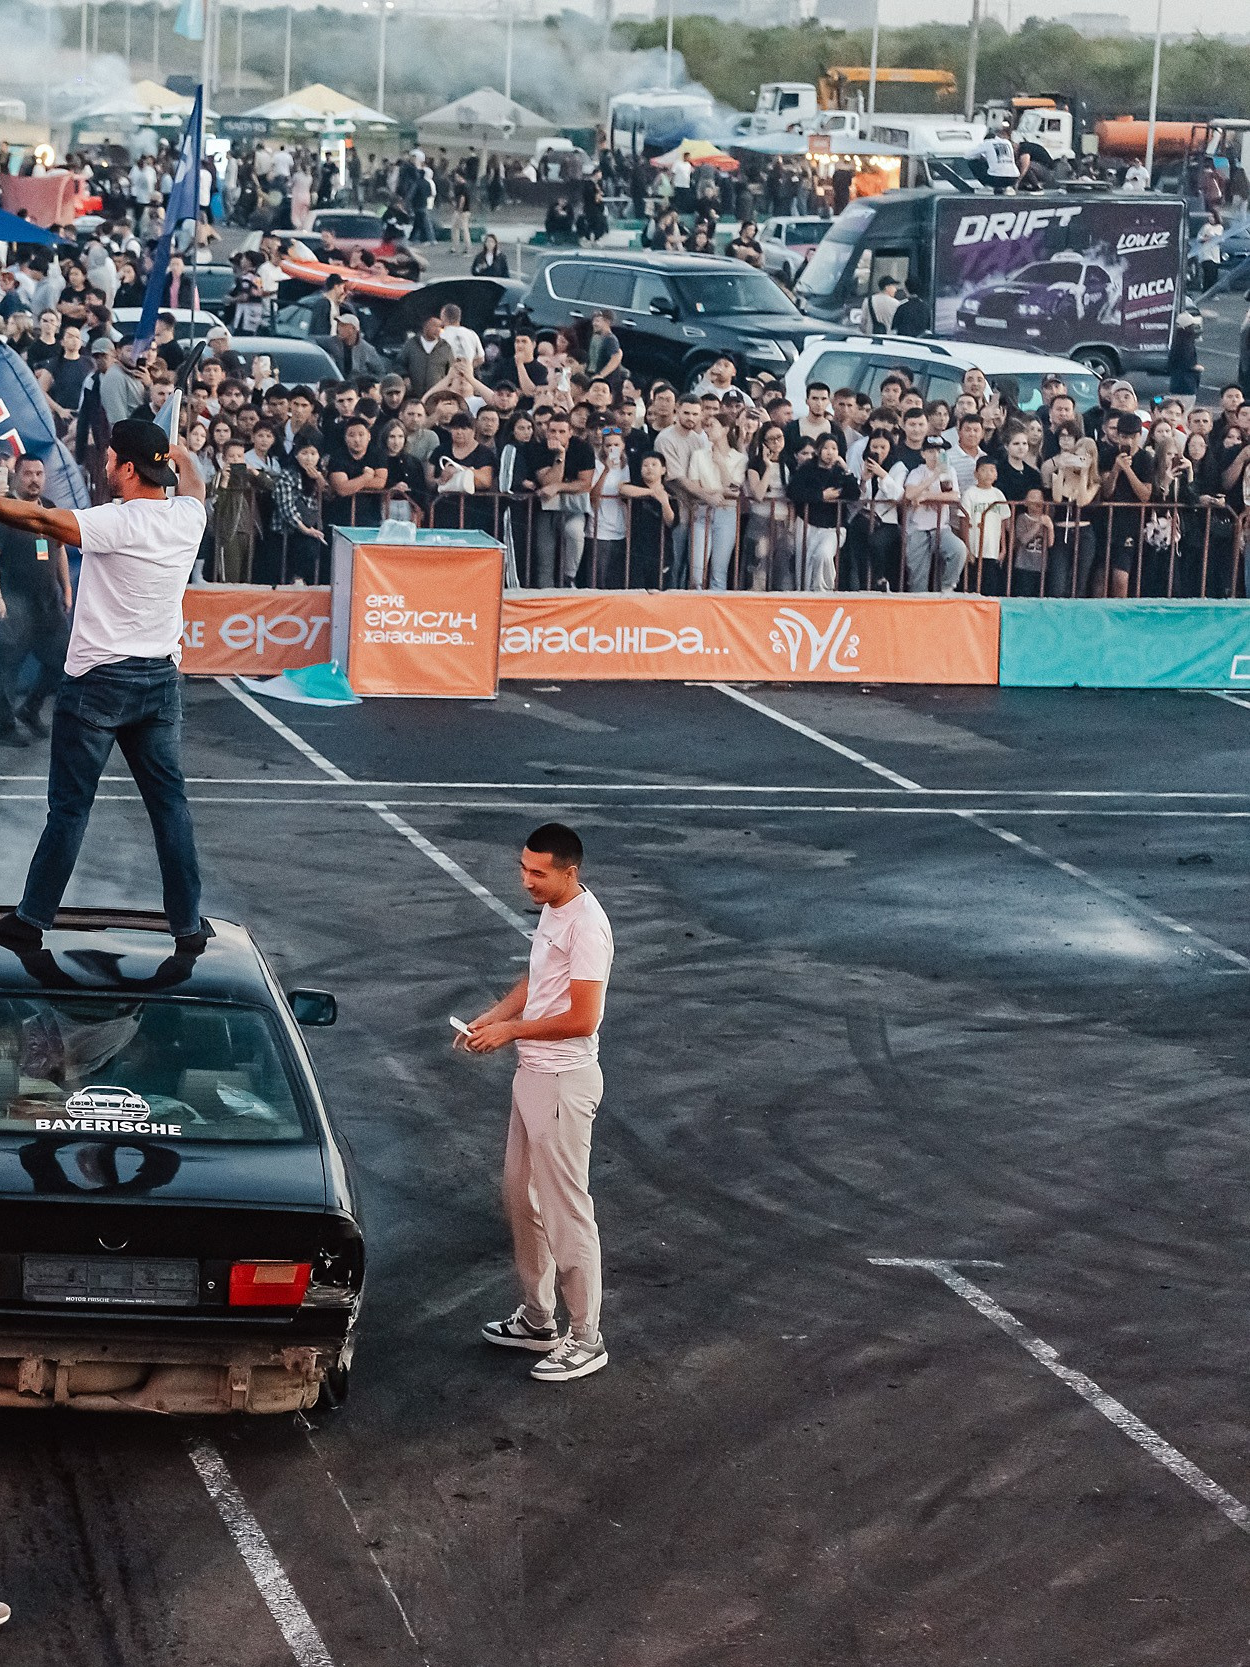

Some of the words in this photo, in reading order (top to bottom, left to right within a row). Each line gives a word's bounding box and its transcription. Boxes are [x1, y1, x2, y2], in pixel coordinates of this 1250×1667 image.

[953, 206, 1082, 246] DRIFT
[1128, 277, 1175, 301] КАССА
[35, 1119, 182, 1136] BAYERISCHE
